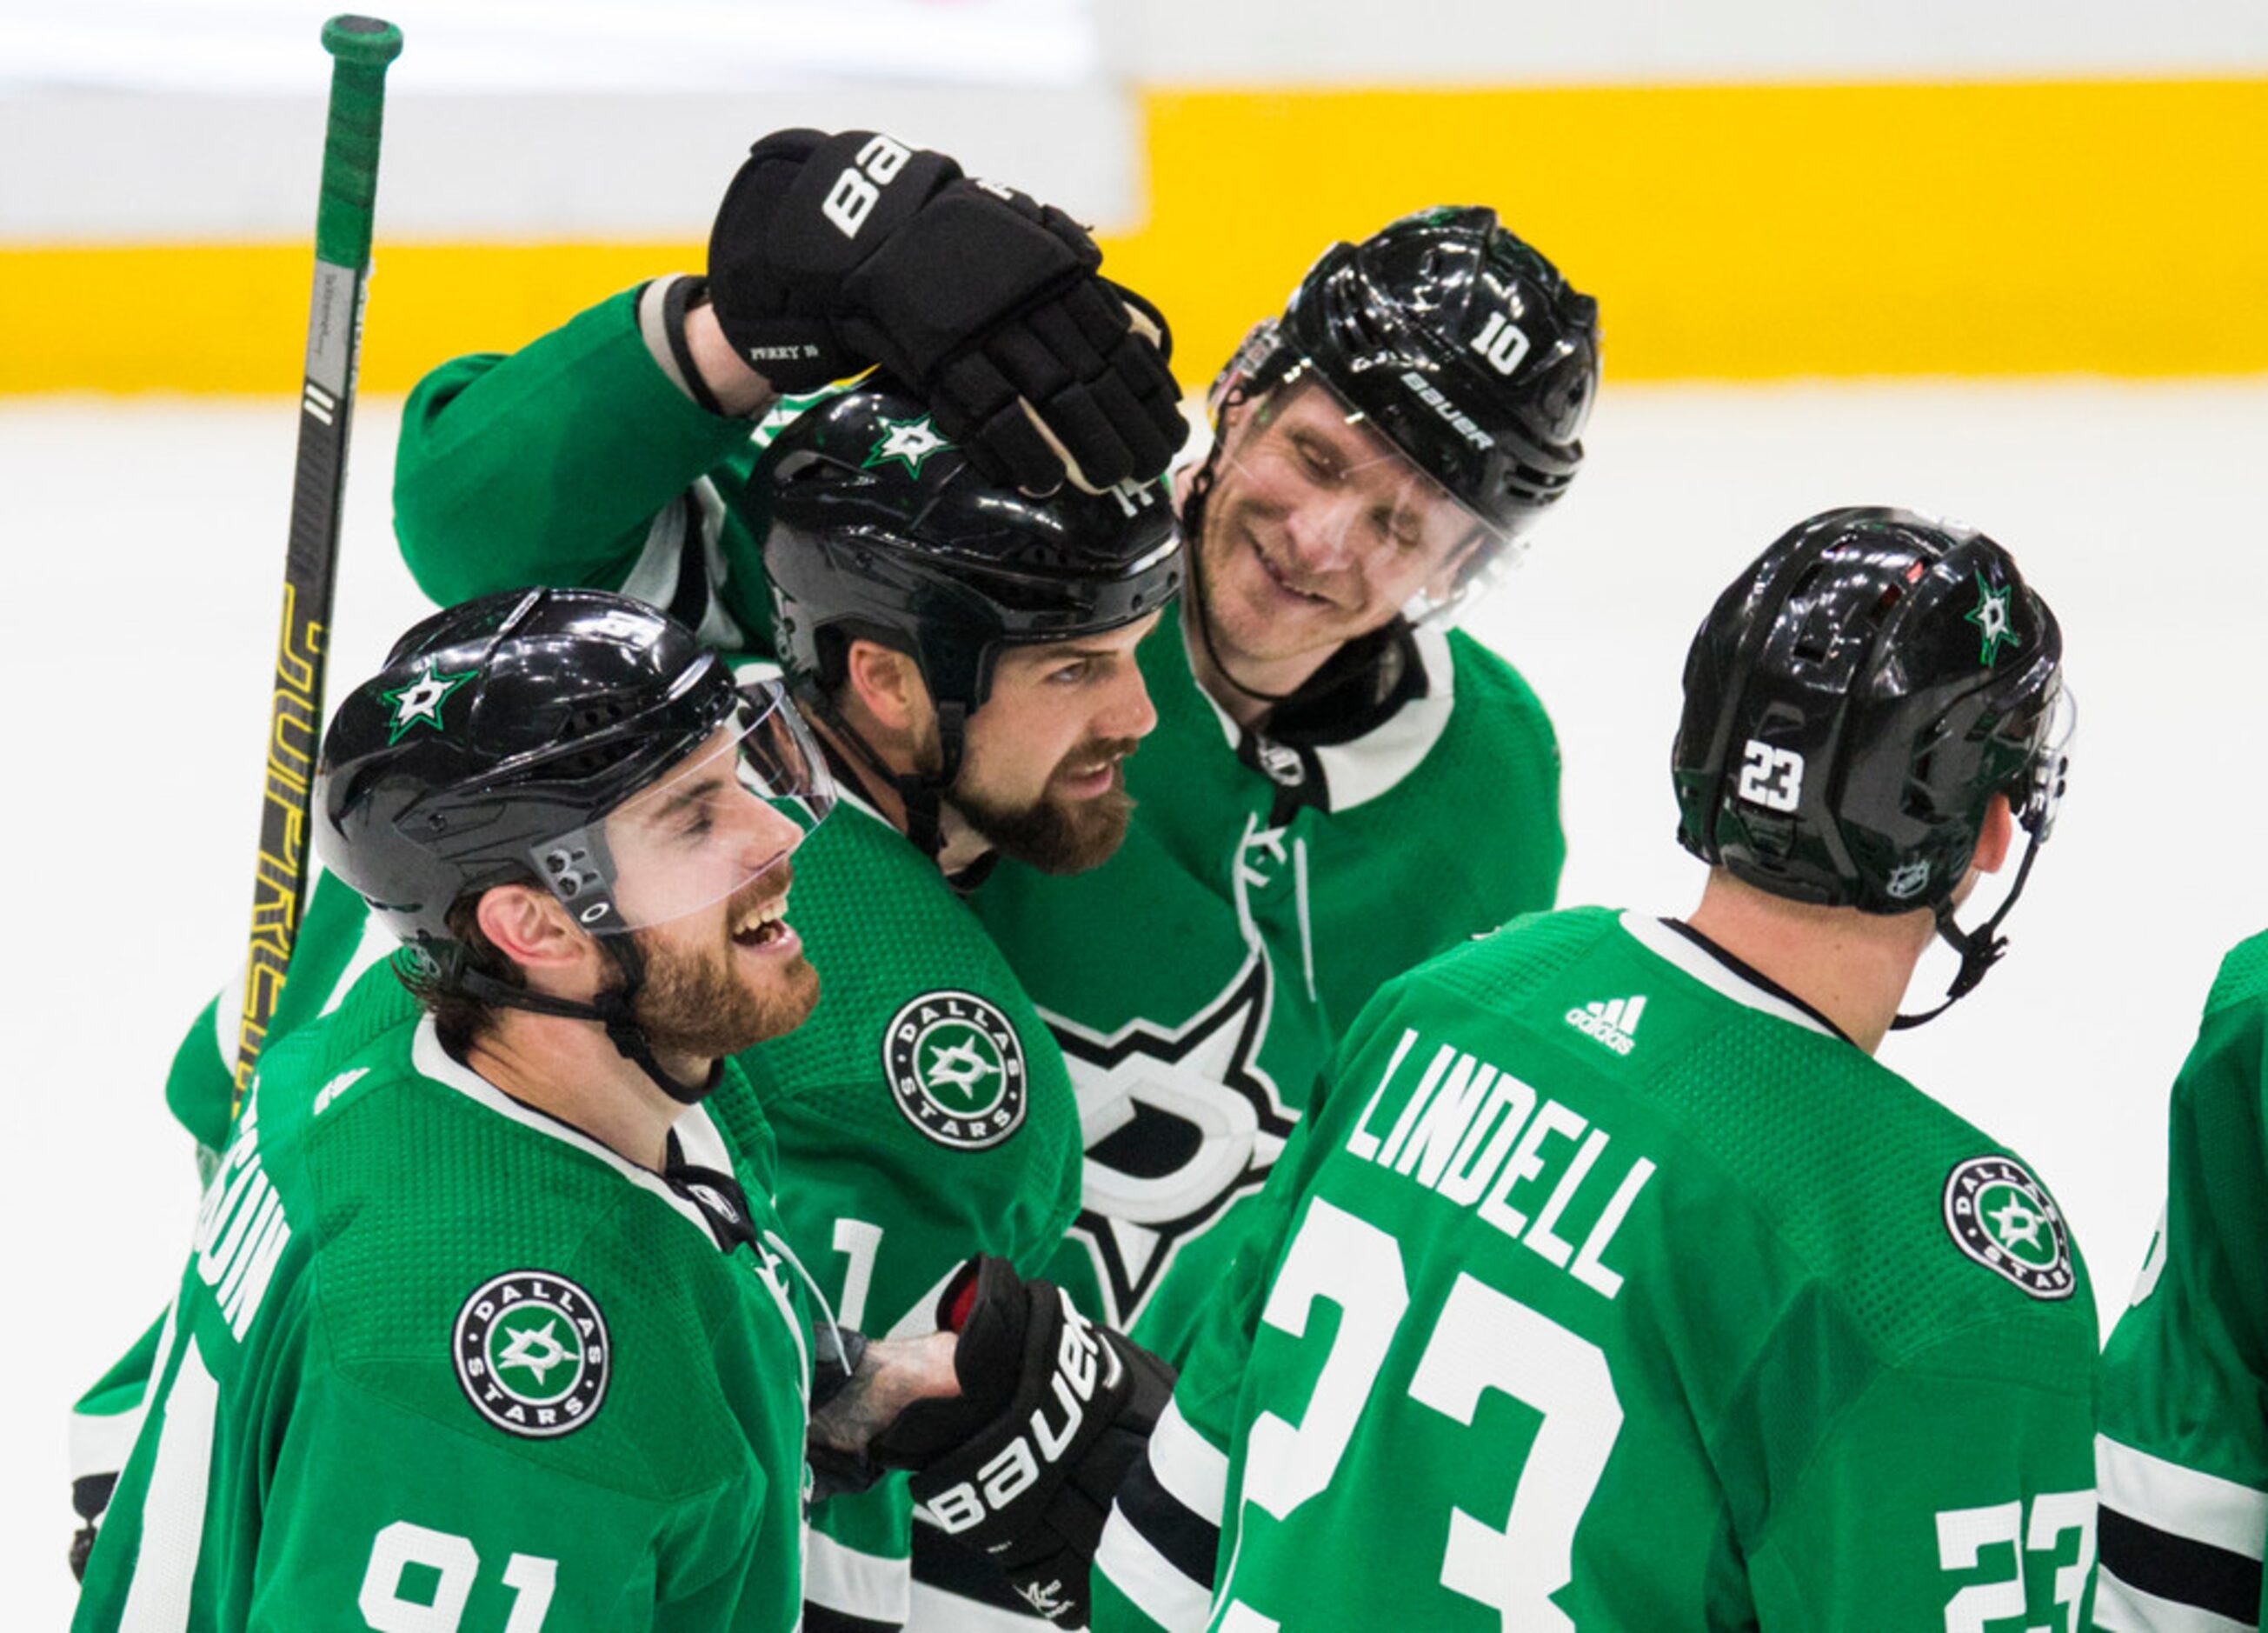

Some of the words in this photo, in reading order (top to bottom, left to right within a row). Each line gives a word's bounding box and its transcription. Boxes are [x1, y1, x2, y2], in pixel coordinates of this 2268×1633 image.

[1470, 310, 1531, 377] 10
[1738, 738, 1805, 814] 23
[901, 1000, 1020, 1077] DALLAS
[1565, 1008, 1636, 1056] adidas
[901, 1076, 1012, 1138] STARS
[1345, 1027, 1657, 1301] LINDELL
[472, 1281, 602, 1365] DALLAS
[467, 1356, 586, 1426] STARS
[1210, 1193, 1626, 1633] 23
[357, 1520, 558, 1633] 91
[1935, 1488, 2098, 1633] 23
